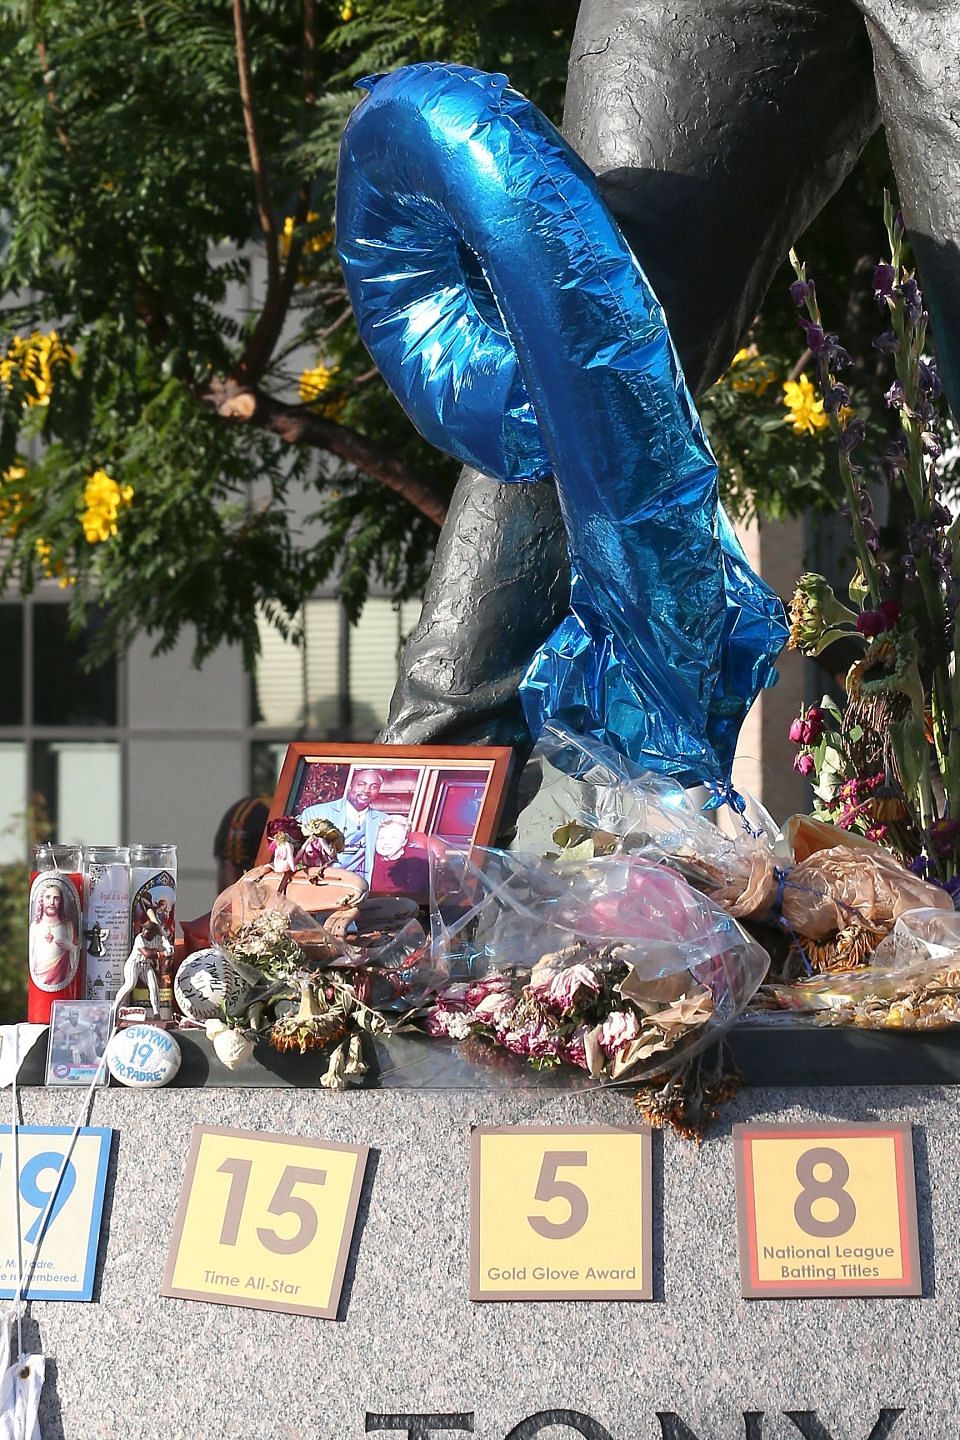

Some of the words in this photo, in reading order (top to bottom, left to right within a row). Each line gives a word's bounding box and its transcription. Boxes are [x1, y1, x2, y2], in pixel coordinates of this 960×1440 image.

[125, 1028, 172, 1052] GWYNN
[129, 1042, 153, 1067] 19
[527, 1151, 589, 1240] 5
[794, 1147, 857, 1238] 8
[216, 1157, 328, 1255] 15
[763, 1245, 831, 1259] National
[836, 1245, 895, 1261] League
[10, 1272, 79, 1283] rembered.
[203, 1269, 240, 1287] Time
[244, 1276, 301, 1295] All-Star
[487, 1267, 526, 1280] Gold
[532, 1267, 580, 1280] Glove
[585, 1266, 636, 1280] Award
[781, 1264, 836, 1281] Batting
[841, 1264, 880, 1277] Titles
